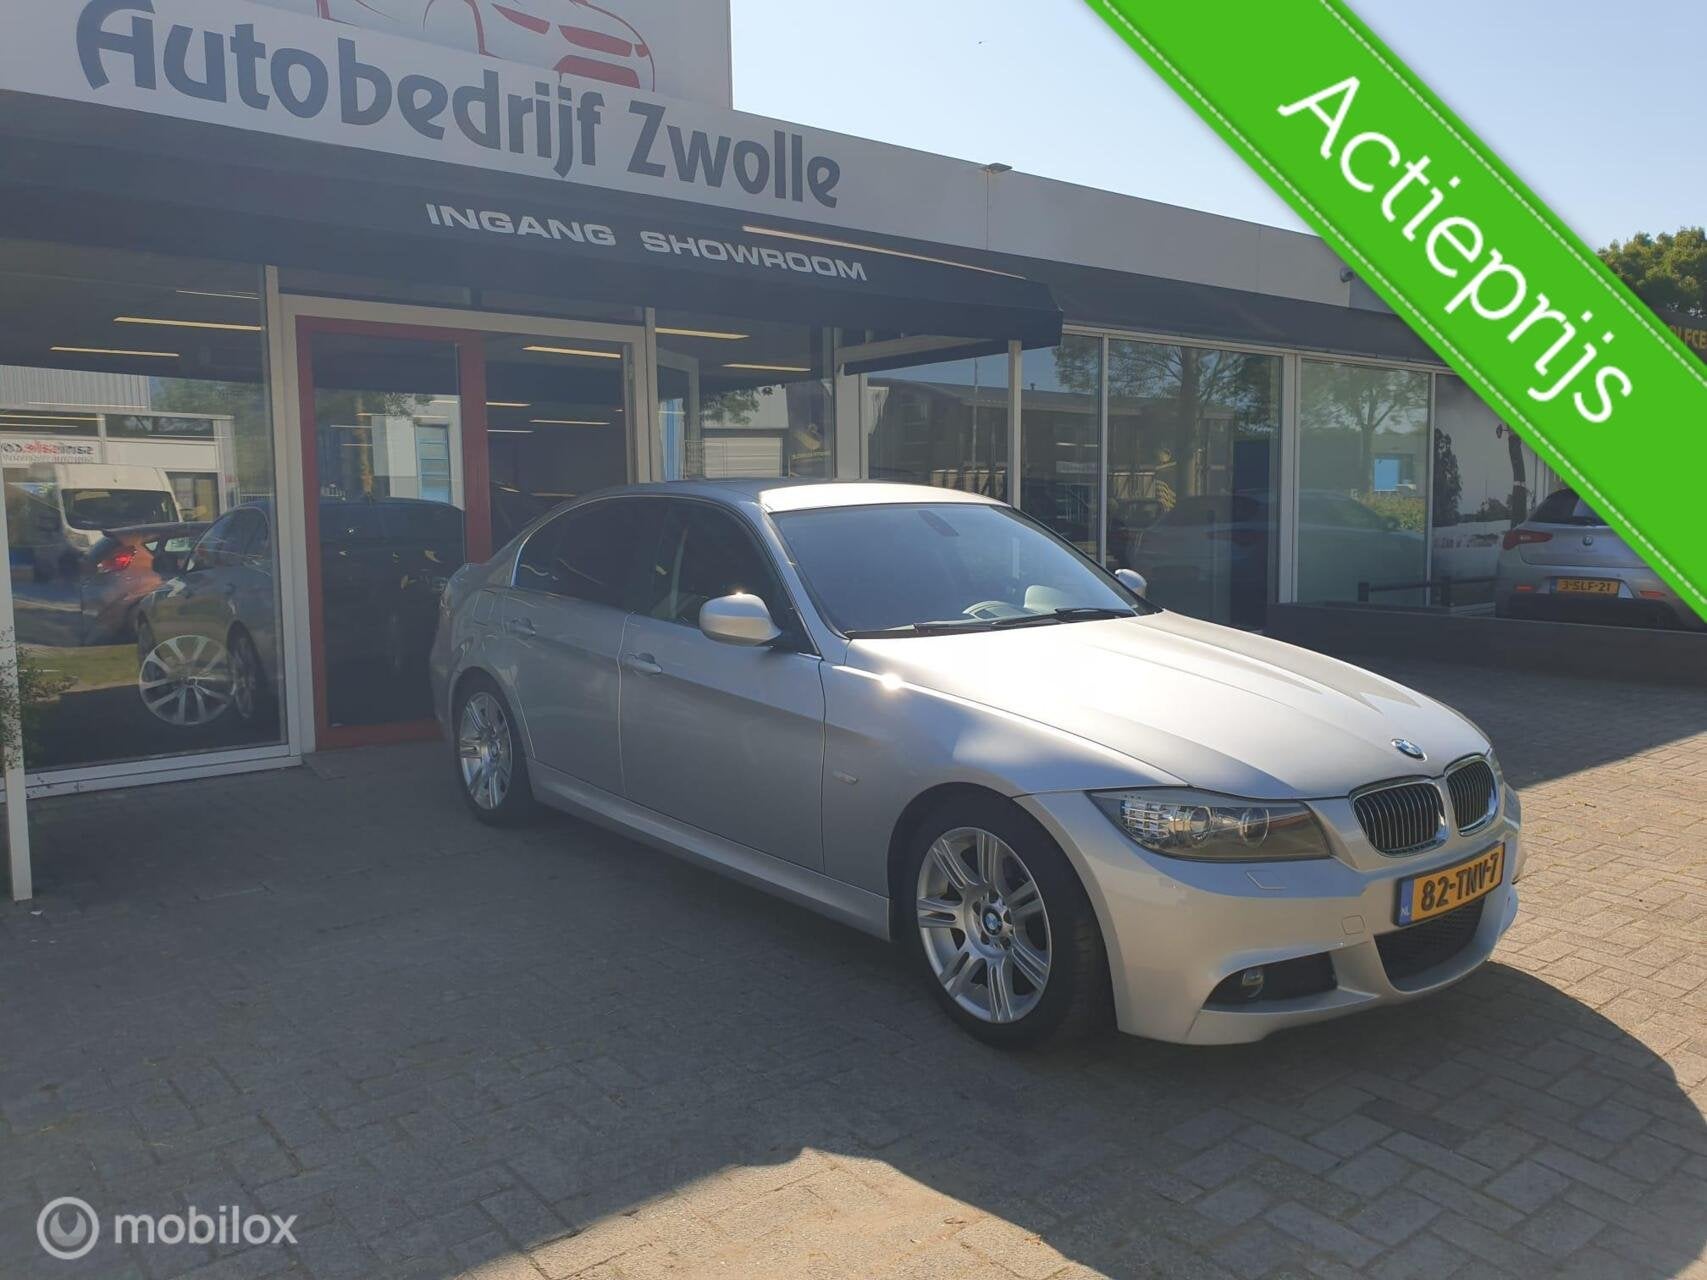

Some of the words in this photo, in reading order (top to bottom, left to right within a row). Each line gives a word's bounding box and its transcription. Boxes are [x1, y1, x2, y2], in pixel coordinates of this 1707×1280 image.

[76, 1, 604, 178] Autobedrijf
[627, 101, 841, 208] Zwolle
[426, 203, 616, 246] INGANG
[640, 231, 868, 281] SHOWROOM
[1421, 853, 1498, 911] 82-TNV-7
